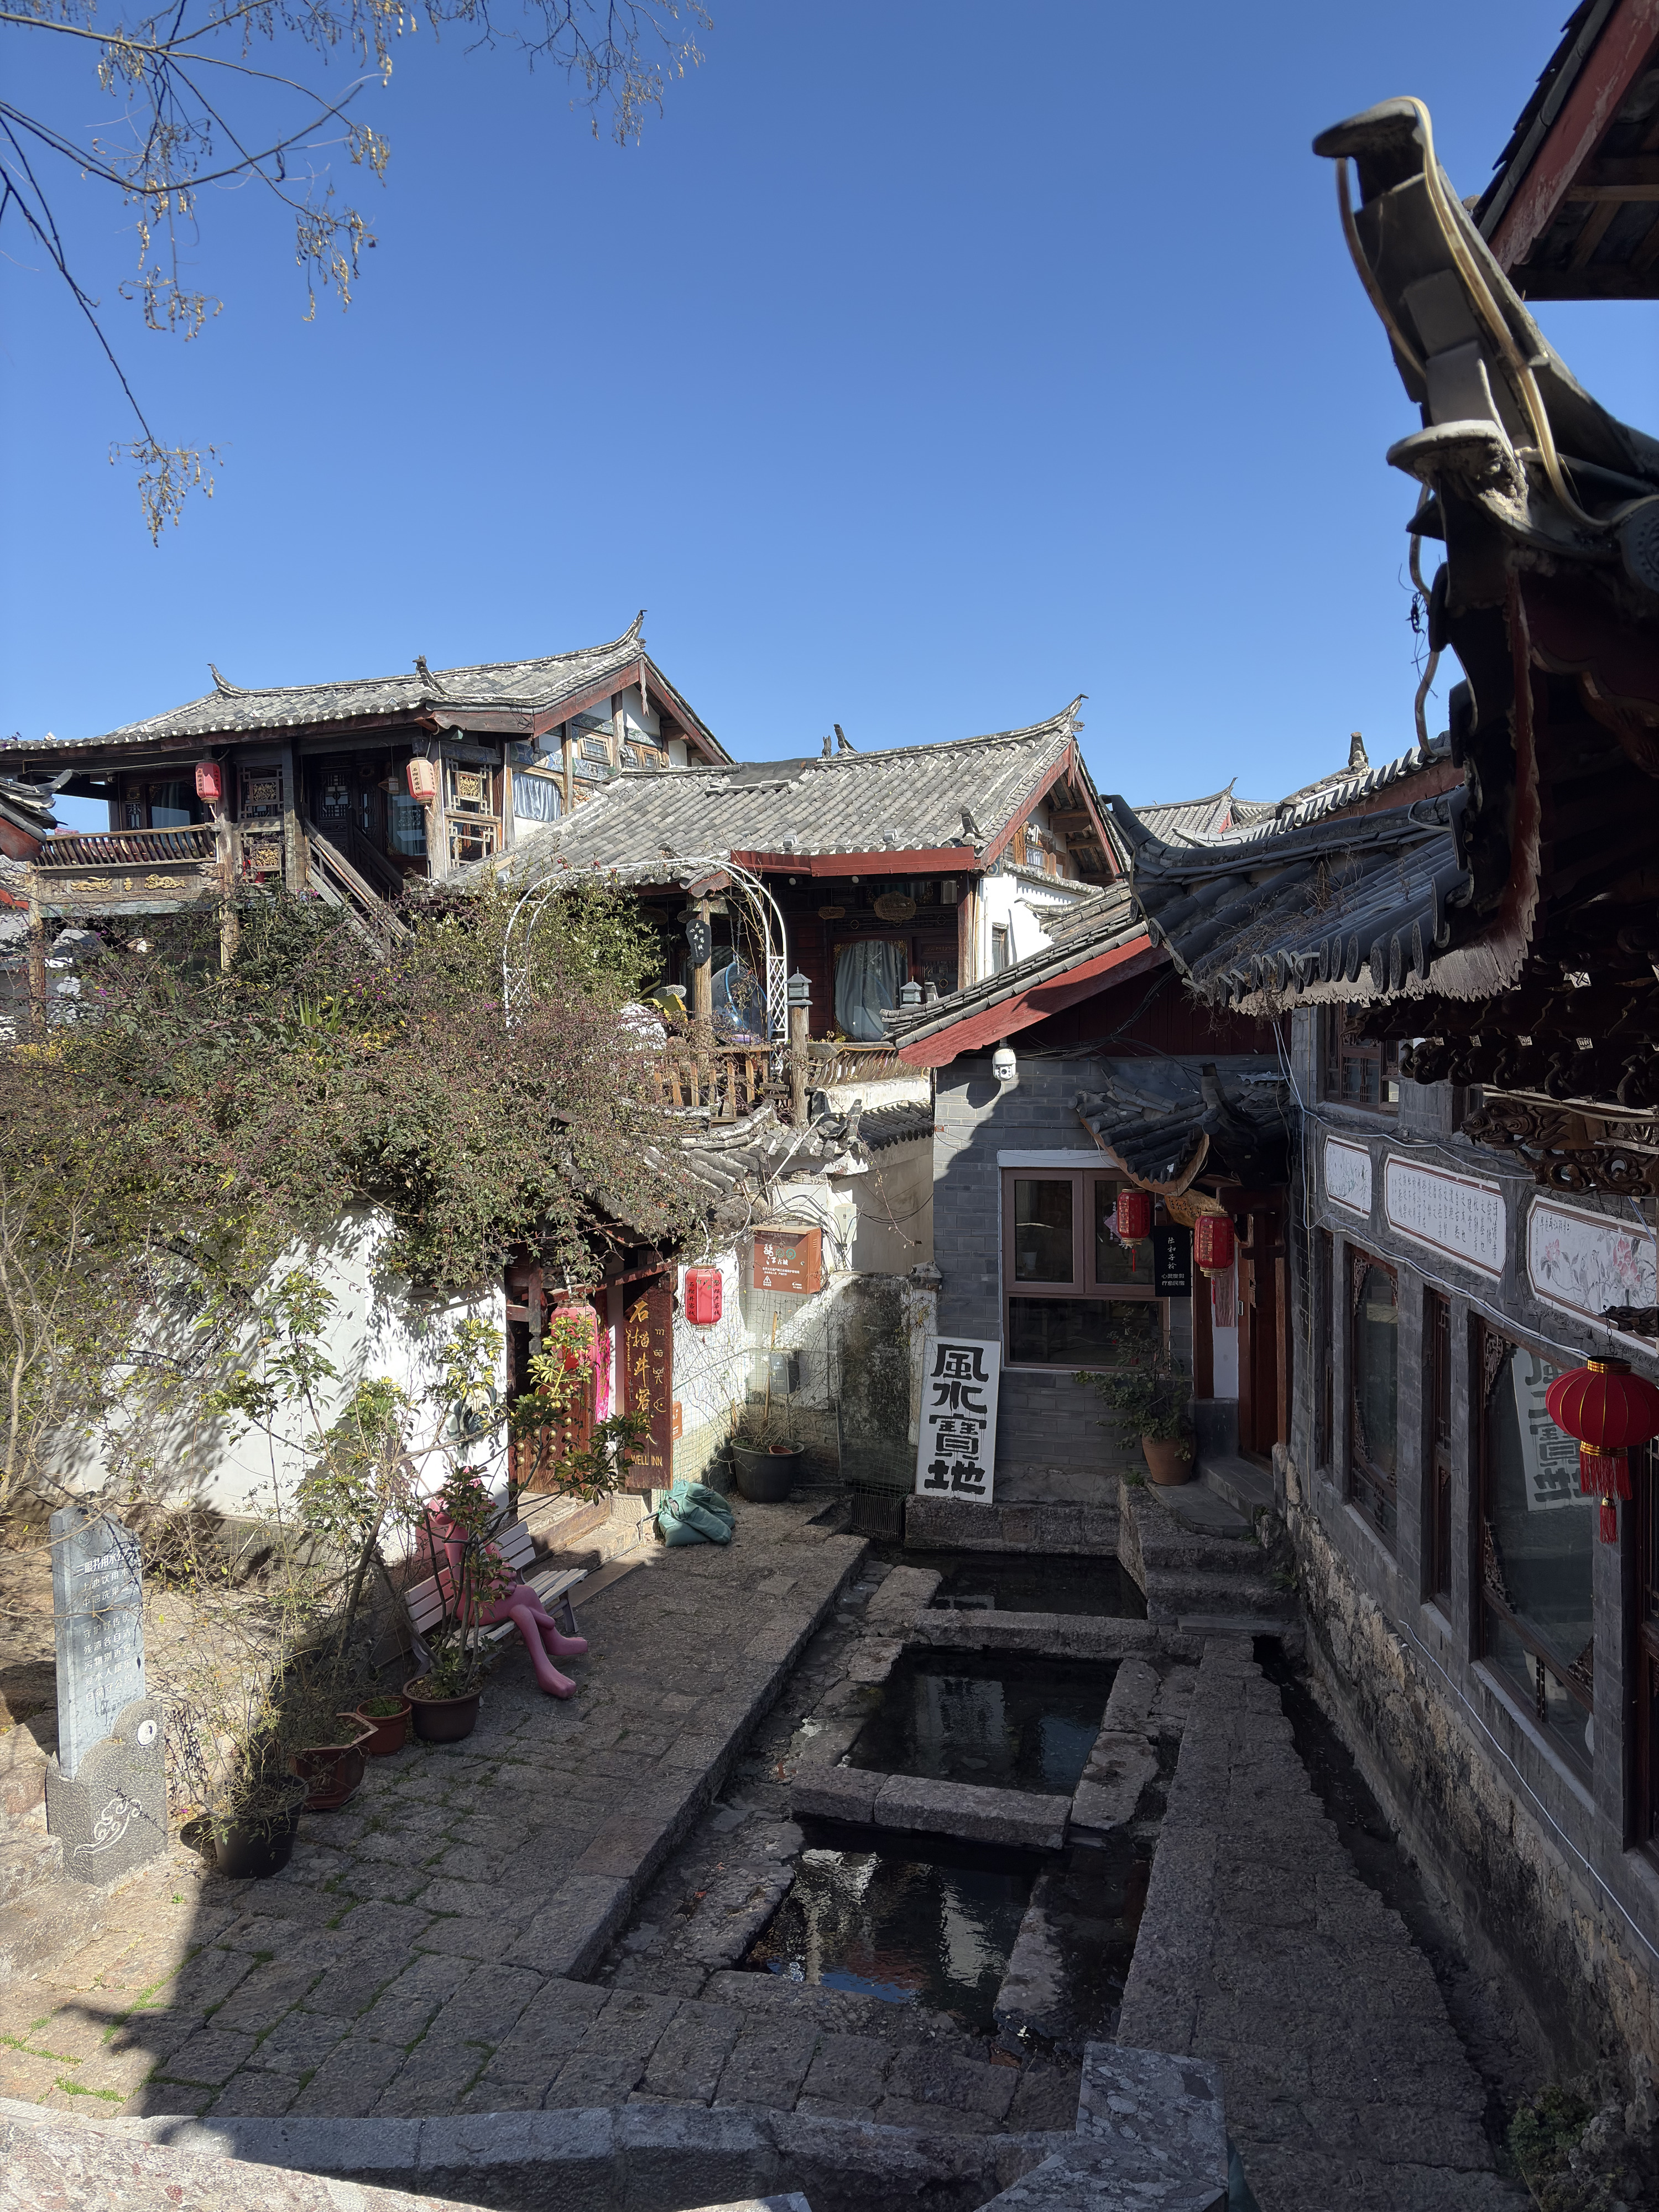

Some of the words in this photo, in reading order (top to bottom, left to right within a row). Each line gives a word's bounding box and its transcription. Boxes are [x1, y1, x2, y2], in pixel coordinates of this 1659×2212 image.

[924, 1343, 989, 1495] 風水寶地
[631, 1454, 649, 1465] WELL
[651, 1455, 662, 1466] INN
[84, 1613, 131, 1639] 守护好传统
[84, 1627, 131, 1656] 残渣各自清
[85, 1643, 132, 1671] 污物别近泉
[85, 1658, 132, 1687] 爱水人康乐
[86, 1674, 133, 1702] 自觉守公约
